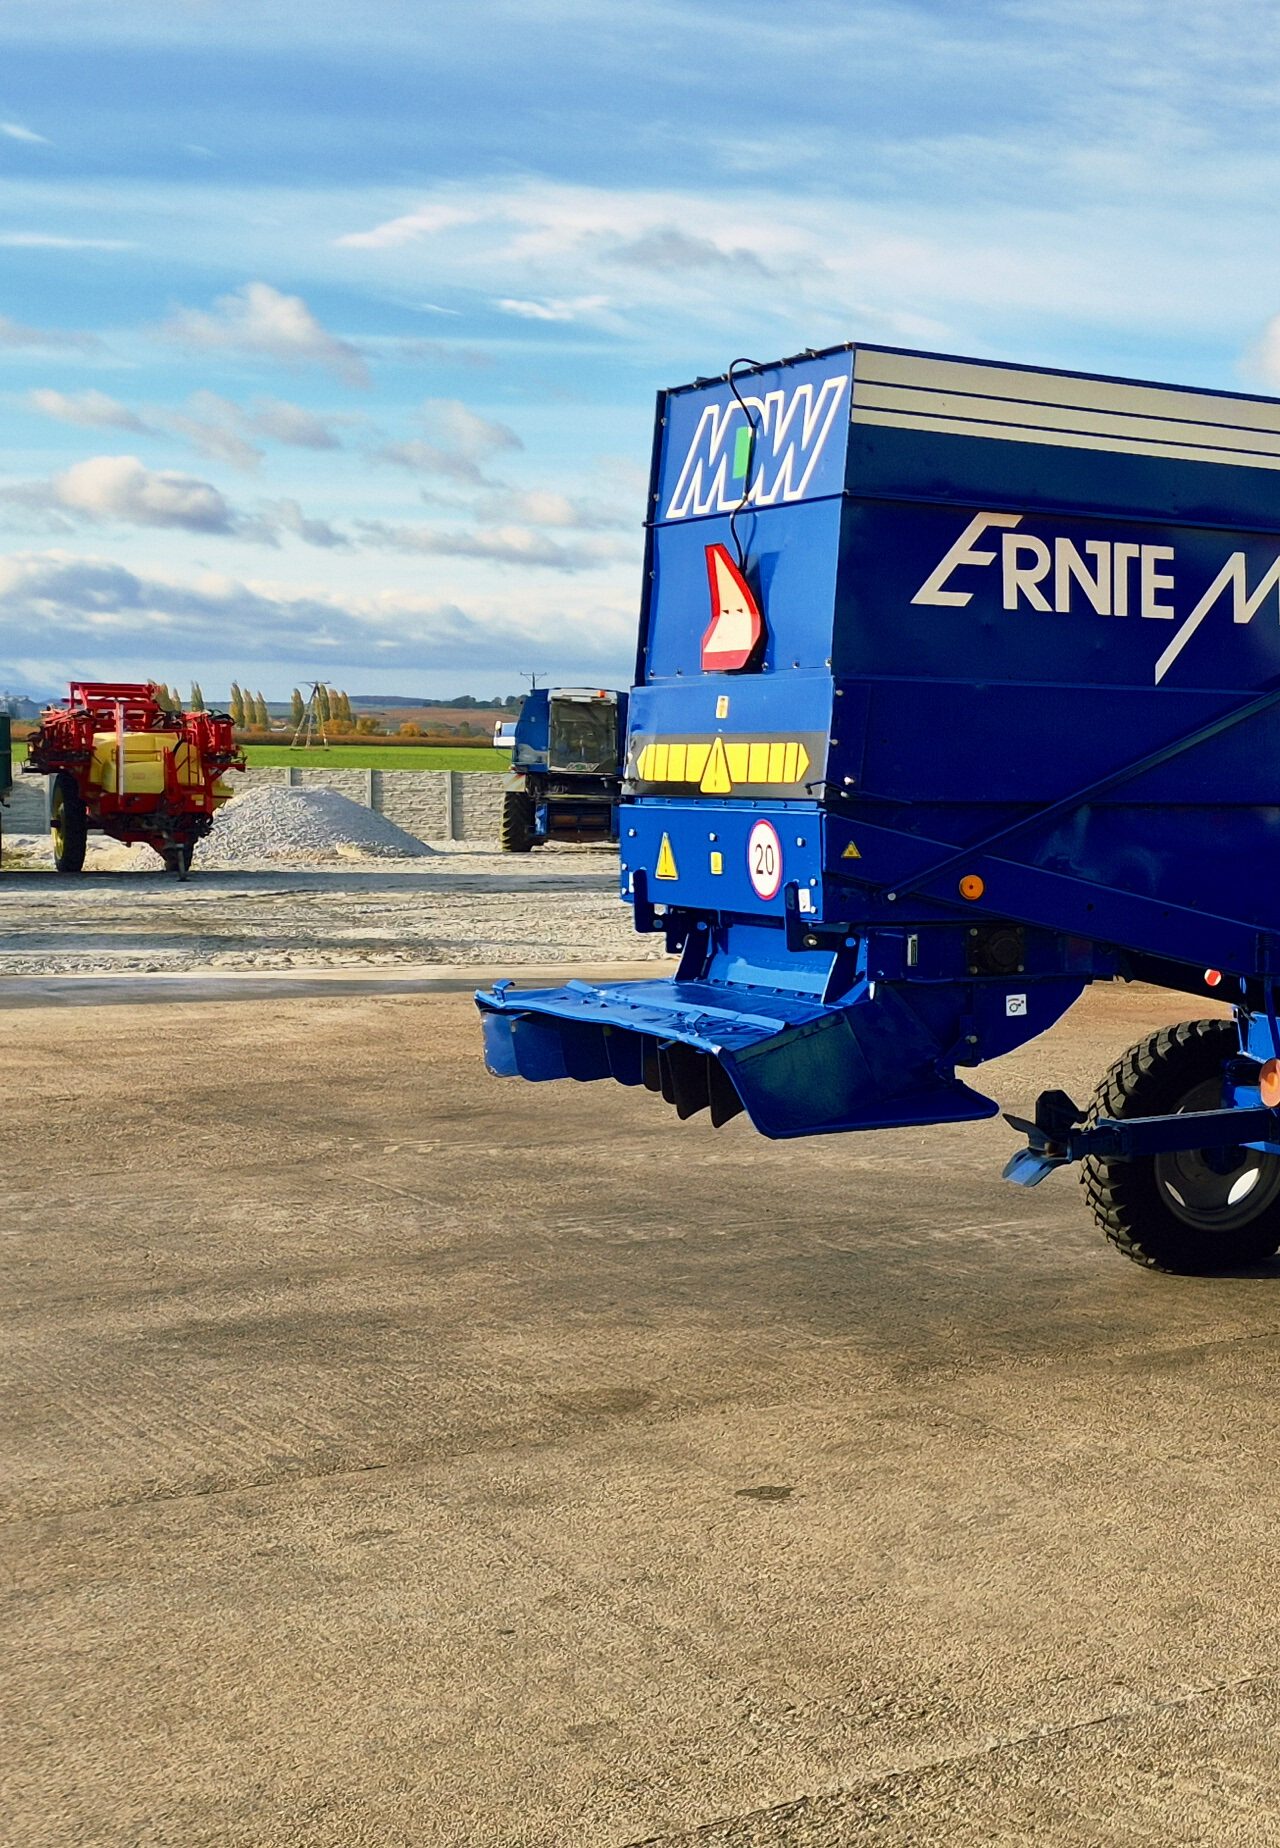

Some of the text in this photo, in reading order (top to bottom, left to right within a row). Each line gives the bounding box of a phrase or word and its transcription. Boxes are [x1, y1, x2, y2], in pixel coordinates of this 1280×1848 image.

[666, 375, 847, 518] MDW
[911, 511, 1174, 619] ERNTE
[754, 844, 775, 875] 20
